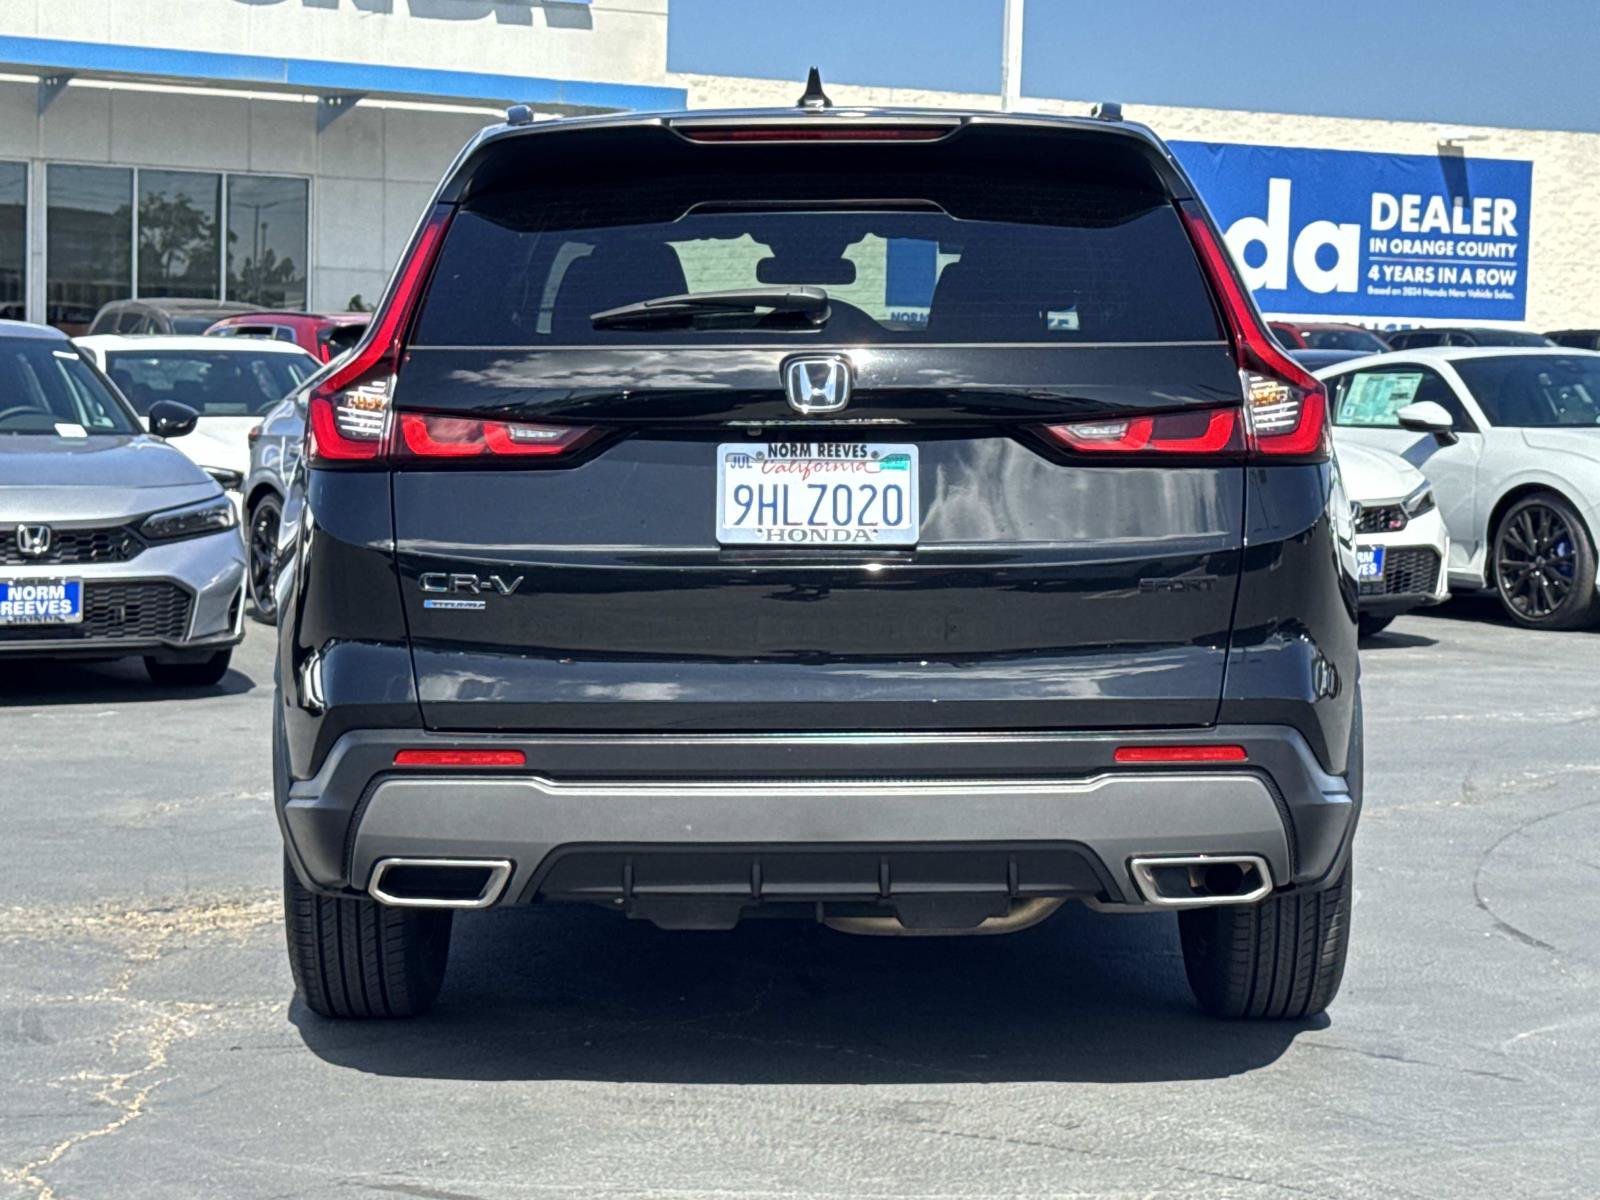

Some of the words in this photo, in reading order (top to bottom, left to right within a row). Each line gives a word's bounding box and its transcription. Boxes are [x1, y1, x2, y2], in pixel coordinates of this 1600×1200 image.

[1370, 192, 1518, 237] DEALER
[1369, 237, 1388, 253] IN
[1390, 238, 1455, 256] ORANGE
[1456, 241, 1518, 258] COUNTY
[1368, 264, 1380, 281] 4
[1383, 265, 1435, 283] YEARS
[1438, 267, 1457, 284] IN
[1459, 267, 1473, 284] A
[1475, 268, 1518, 286] ROW
[767, 443, 812, 458] NORM
[817, 444, 868, 459] REEVES
[730, 456, 753, 469] JUL
[761, 459, 882, 481] California
[733, 483, 904, 527] 9HLZ020
[766, 528, 873, 542] HONDA
[8, 585, 66, 601] NORM
[420, 572, 524, 596] CR-V
[1139, 576, 1218, 593] SPORT
[0, 599, 73, 616] REEVES
